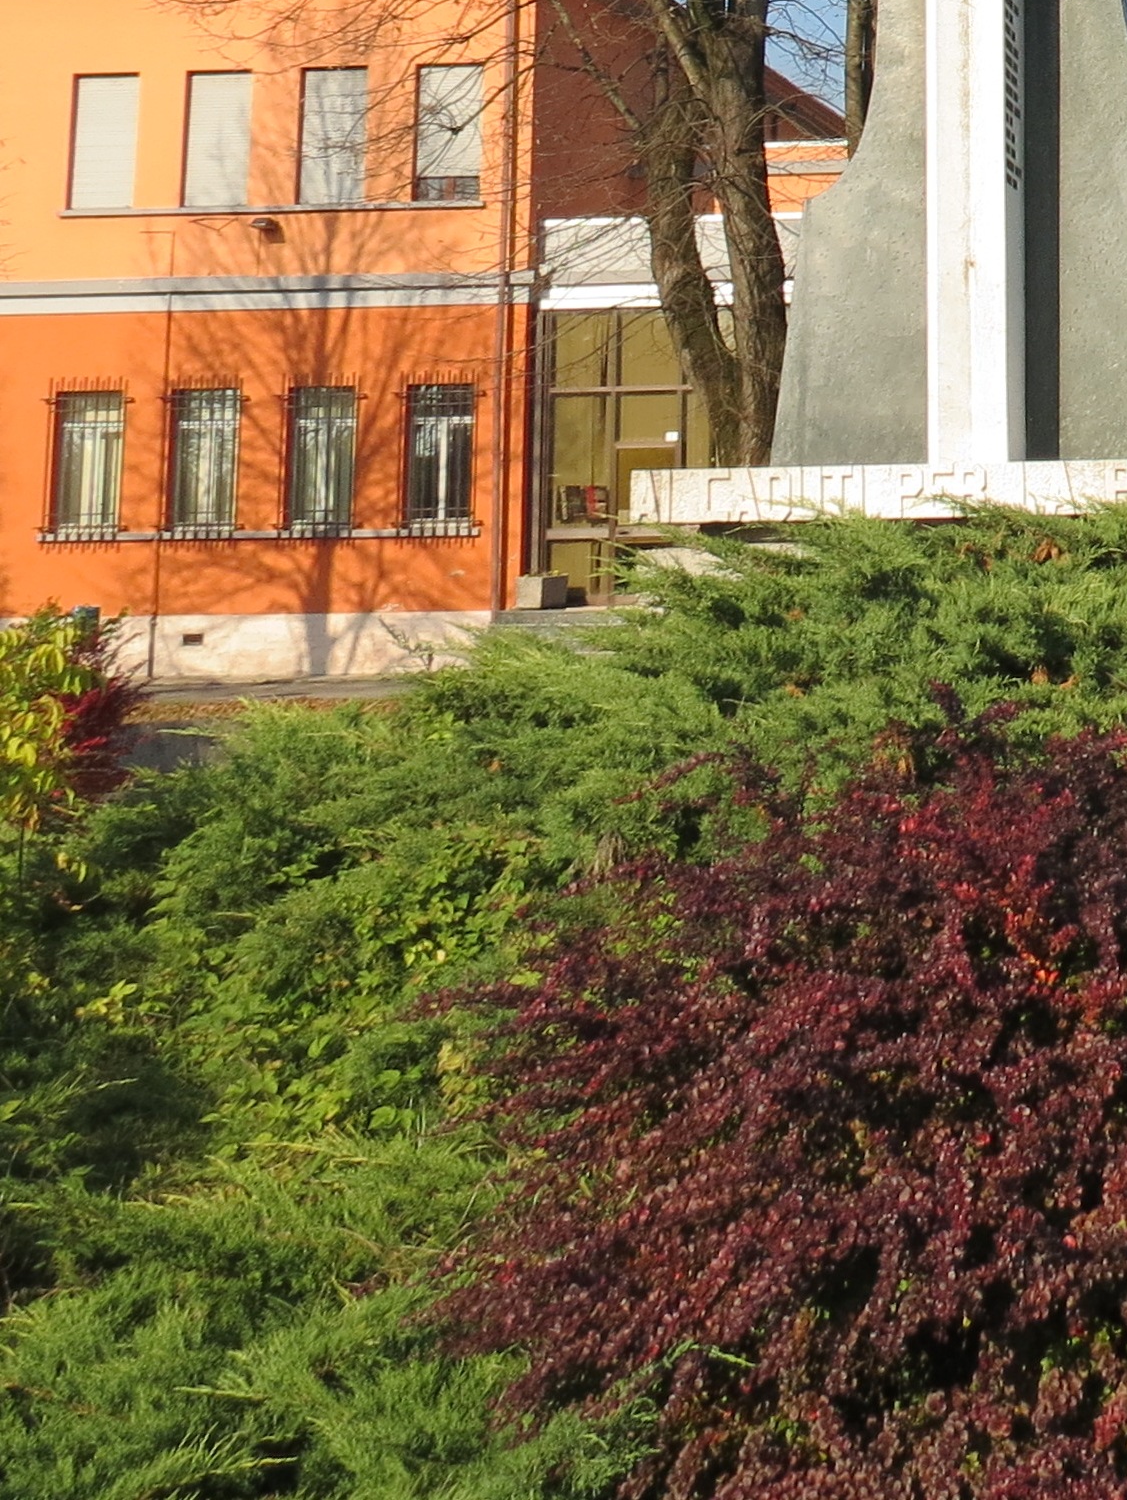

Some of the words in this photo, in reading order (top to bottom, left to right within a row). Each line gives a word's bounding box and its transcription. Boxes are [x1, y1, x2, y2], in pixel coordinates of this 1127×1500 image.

[633, 468, 673, 523] AI
[700, 466, 866, 522] CADUTI
[890, 462, 988, 518] PER
[1012, 461, 1077, 516] LA
